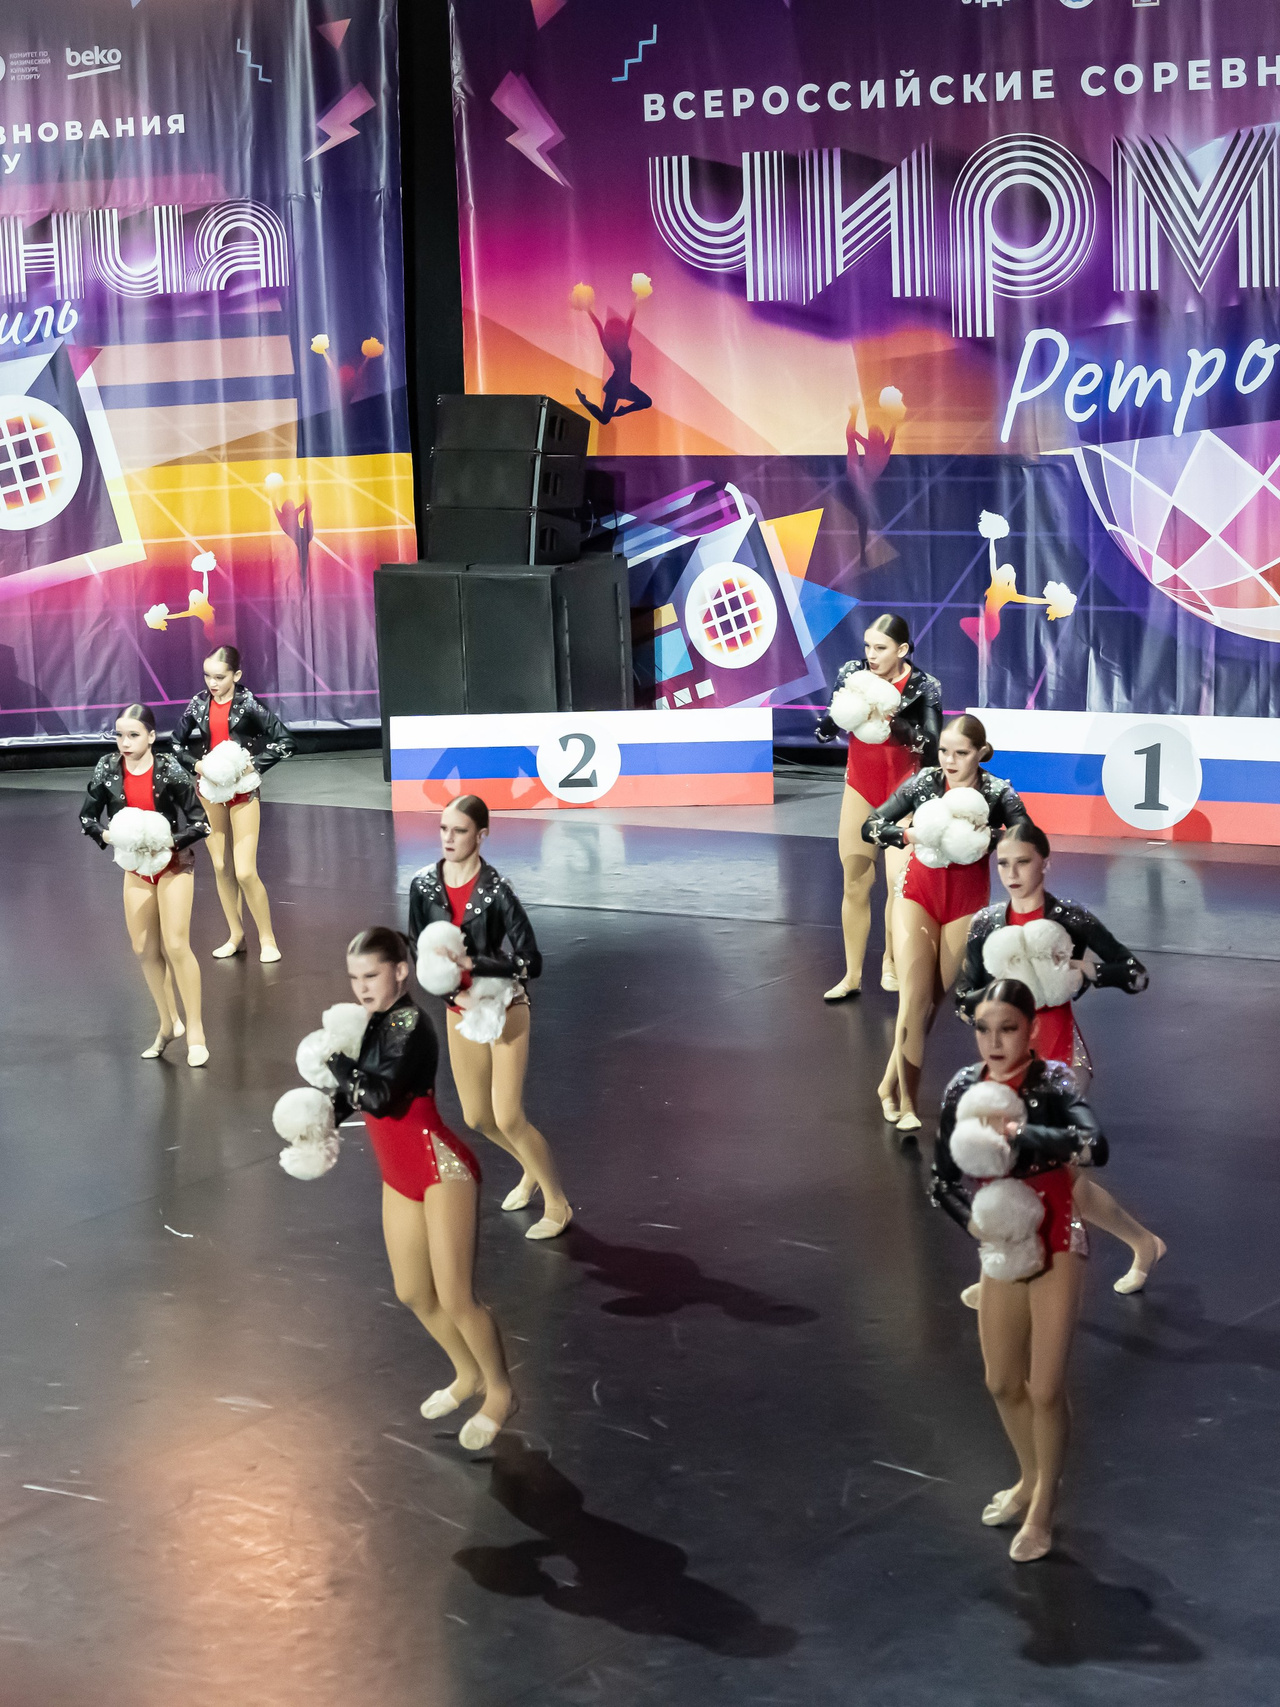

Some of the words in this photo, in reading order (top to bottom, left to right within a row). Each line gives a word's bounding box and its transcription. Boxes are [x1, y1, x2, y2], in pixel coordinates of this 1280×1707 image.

[9, 51, 38, 59] КОМИТЕТ
[9, 57, 51, 66] ФИЗИЧЕСКОЙ
[10, 66, 39, 74] КУЛЬТУРЕ
[65, 45, 122, 67] beko
[644, 69, 1055, 122] ВСЕРОССИЙСКИЕ
[1000, 328, 1280, 443] Ретро
[558, 733, 598, 788] 2
[1133, 742, 1169, 811] 1
